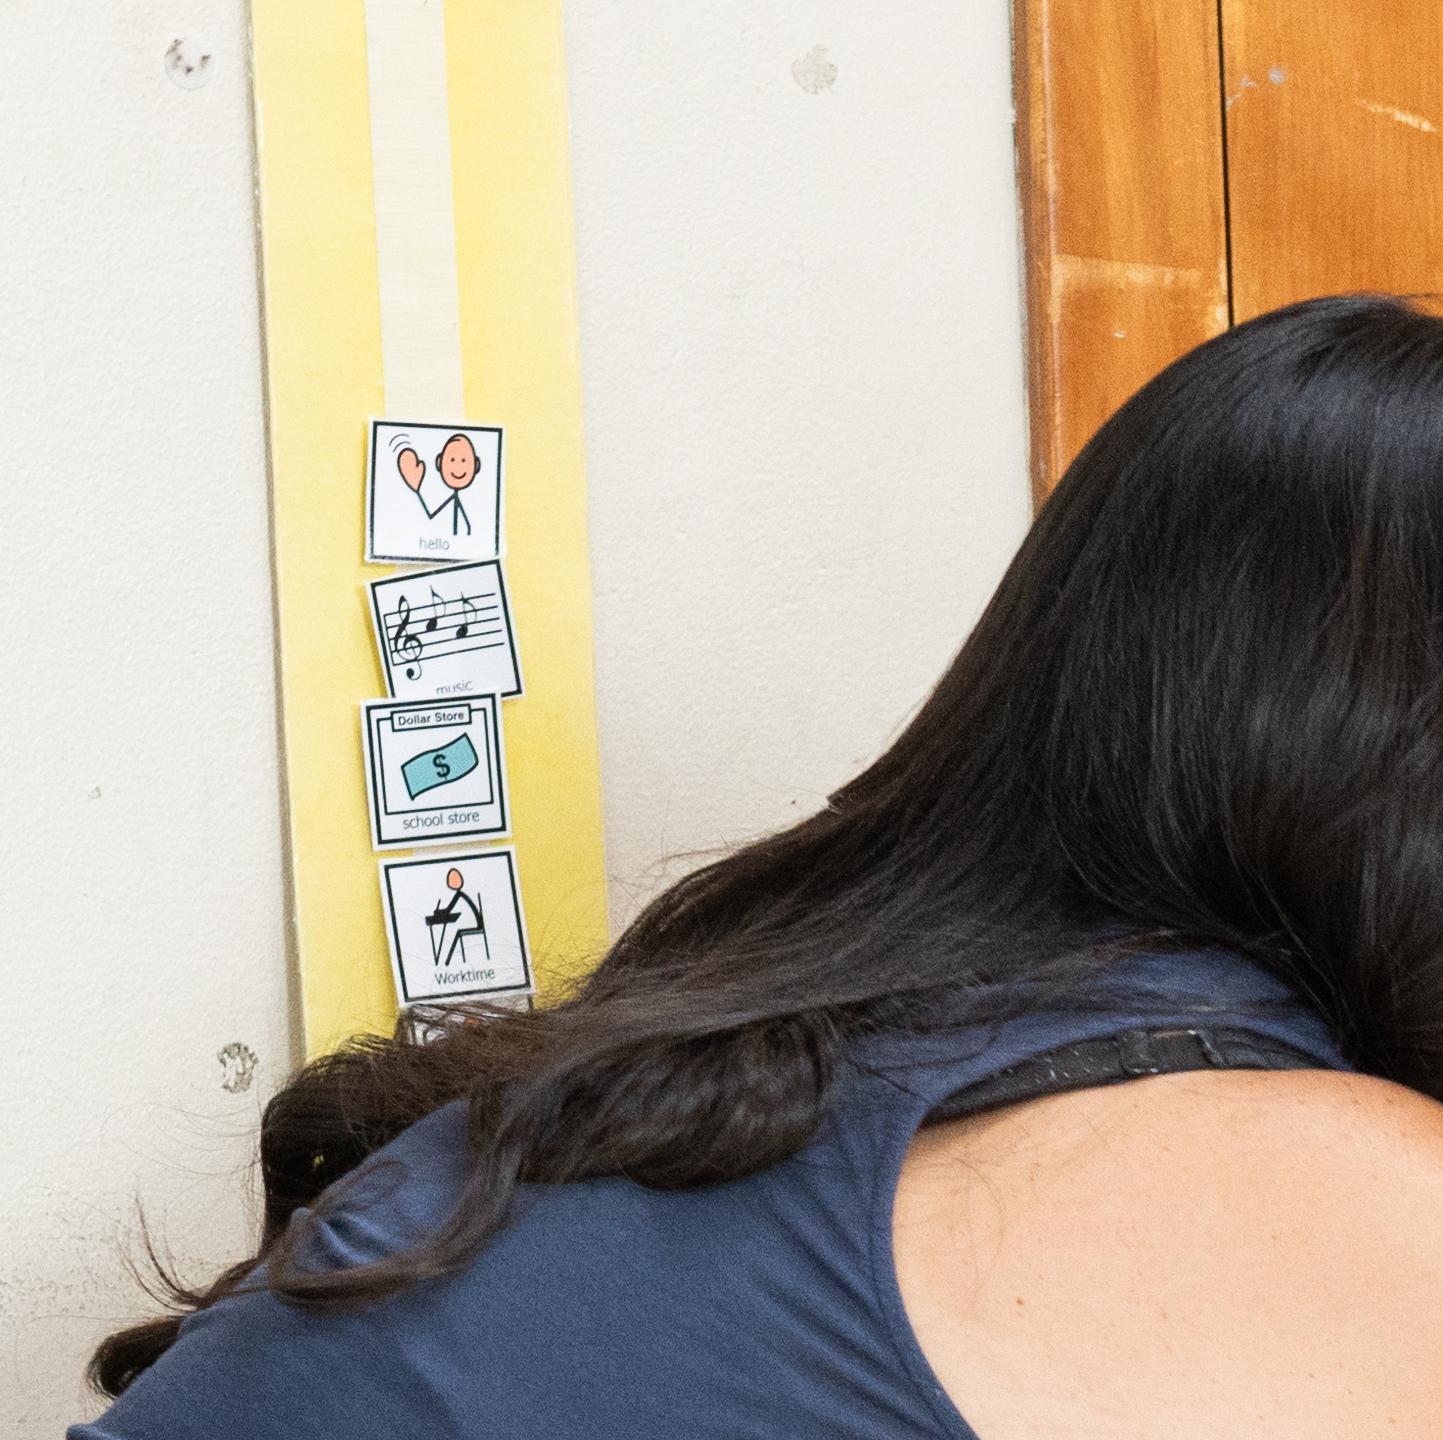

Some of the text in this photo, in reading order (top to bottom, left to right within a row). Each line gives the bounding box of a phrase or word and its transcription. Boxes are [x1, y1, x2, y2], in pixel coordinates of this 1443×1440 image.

[419, 536, 450, 551] hello
[436, 680, 473, 695] music
[398, 711, 465, 726] Dollar Store
[403, 811, 480, 830] school store
[434, 966, 496, 985] Worktime
